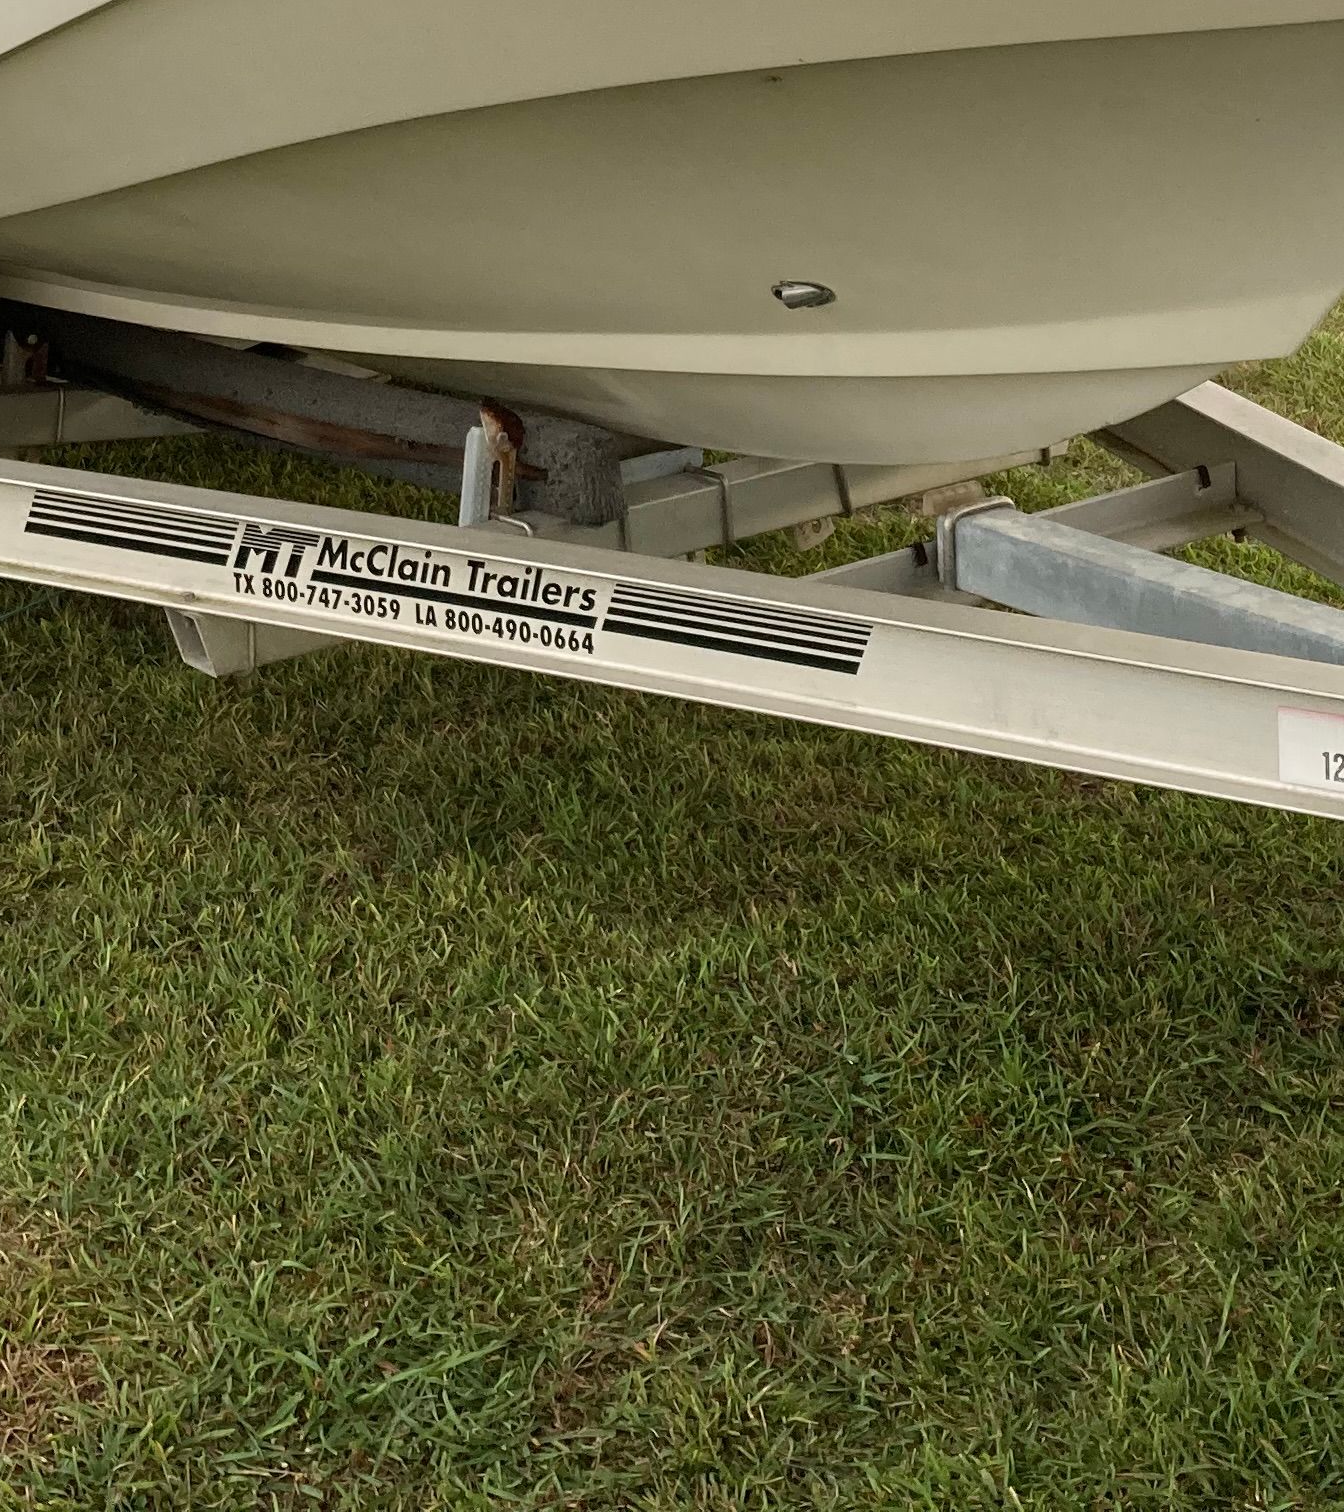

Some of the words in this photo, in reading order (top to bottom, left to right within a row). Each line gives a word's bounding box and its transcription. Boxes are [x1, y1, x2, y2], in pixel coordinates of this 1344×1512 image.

[233, 572, 256, 595] TX
[262, 577, 401, 620] 800-747-3059
[415, 603, 438, 628] LA
[445, 608, 595, 655] 800-490-0664
[316, 536, 452, 588] McClain
[467, 559, 598, 612] Trailers
